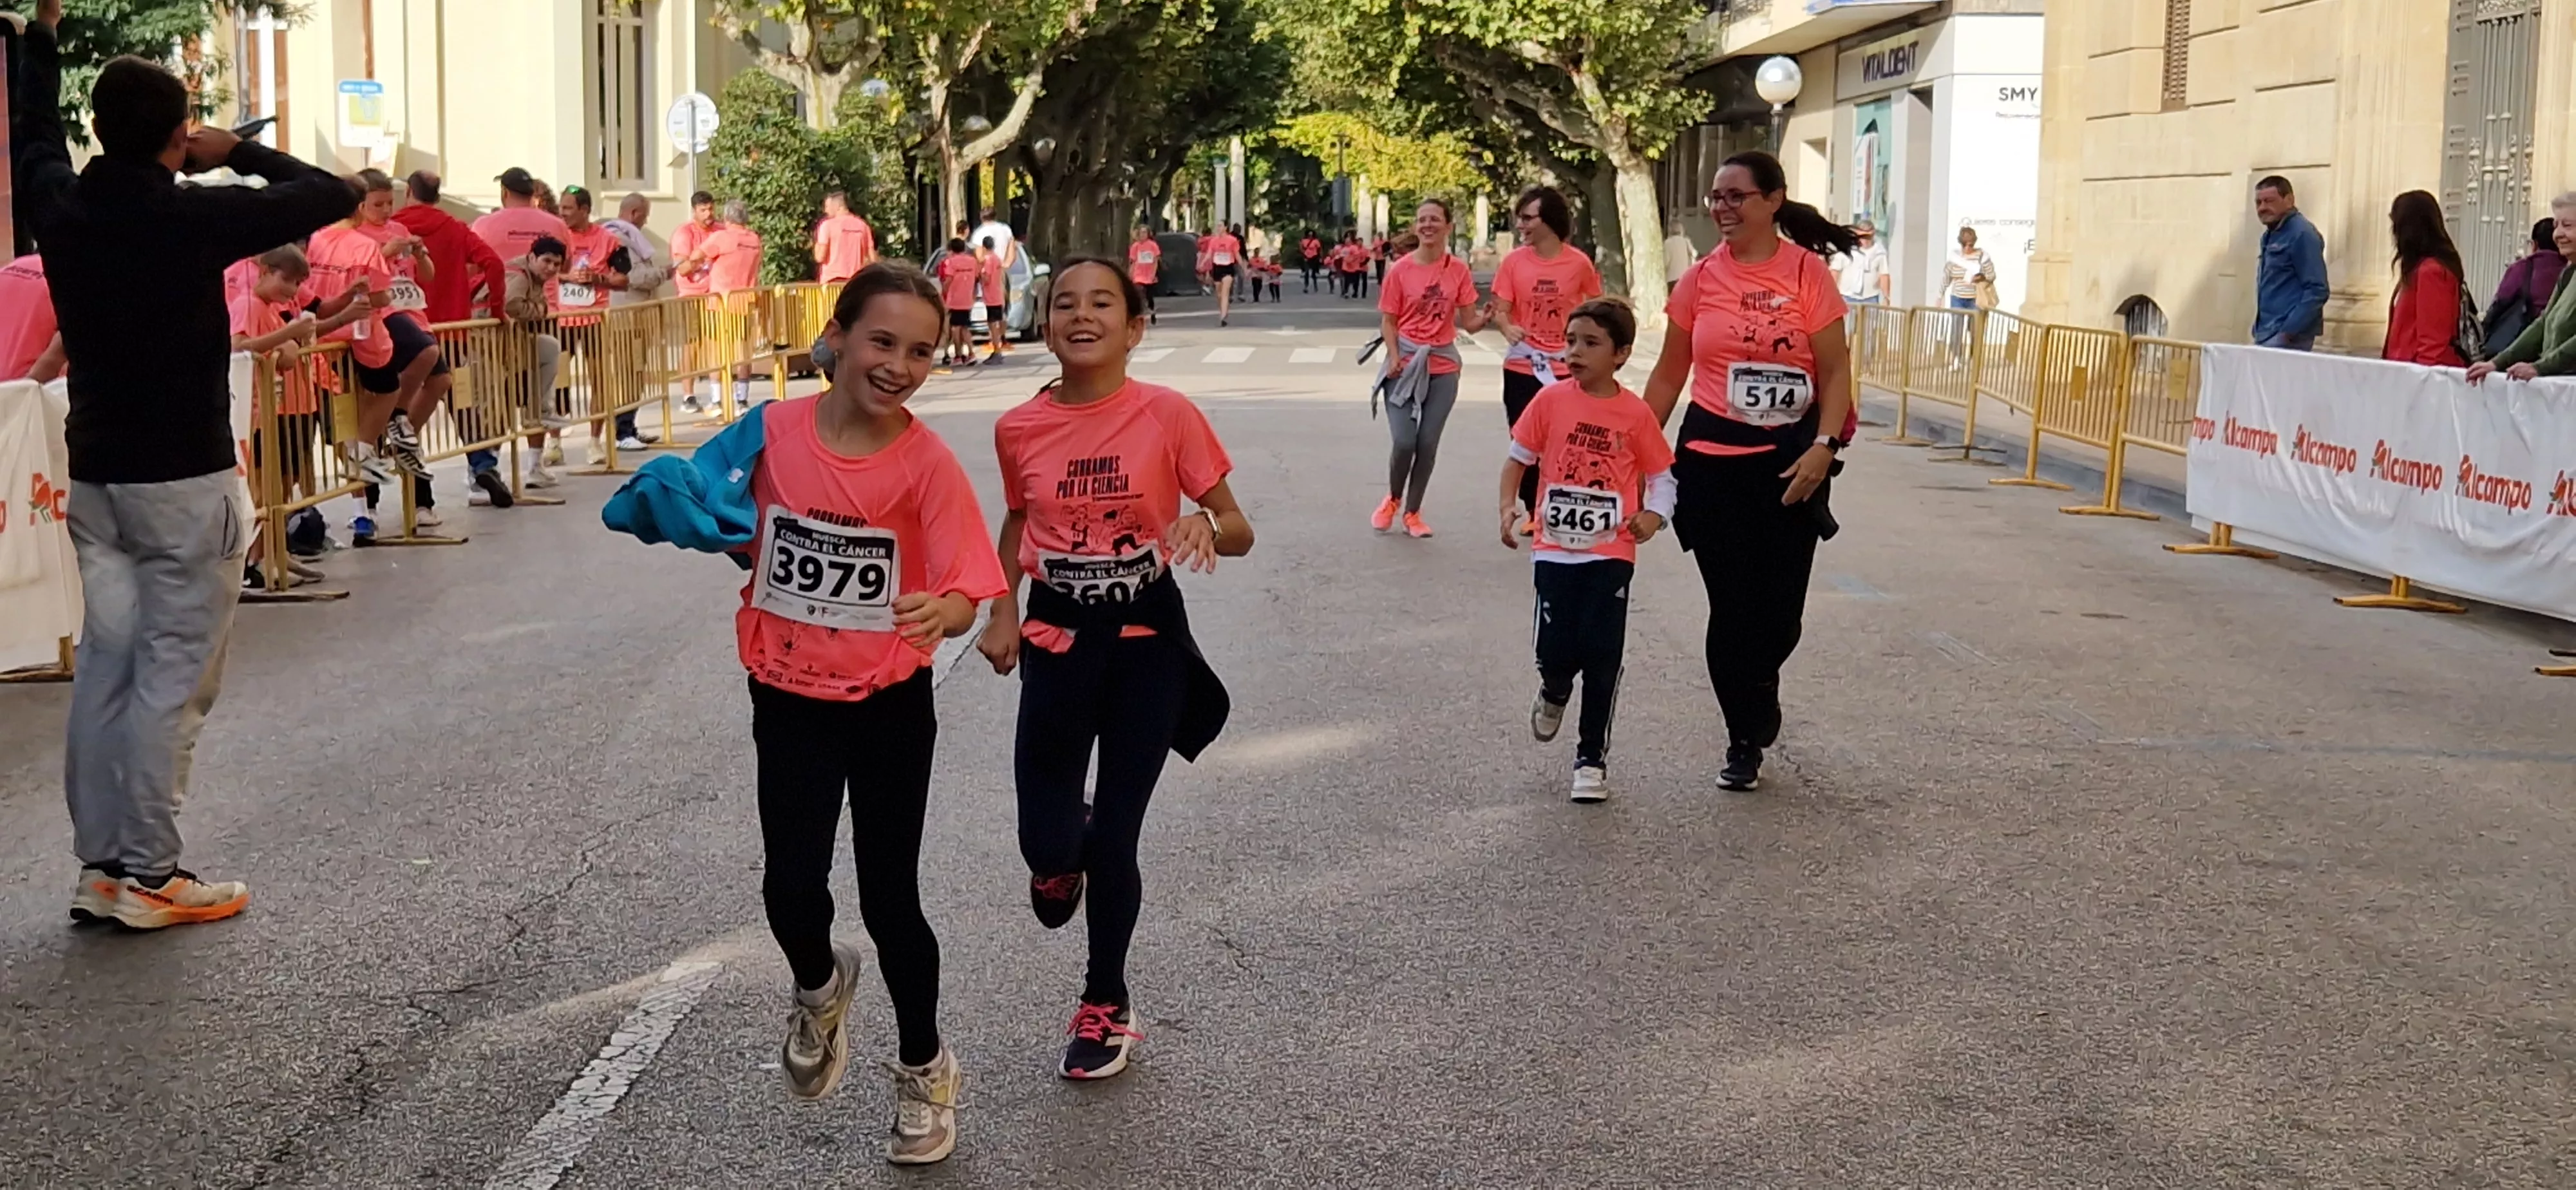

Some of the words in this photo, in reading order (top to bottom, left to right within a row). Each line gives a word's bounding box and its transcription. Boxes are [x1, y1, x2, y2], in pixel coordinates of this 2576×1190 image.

[1862, 41, 1919, 84] VITALDENT
[563, 287, 592, 299] 2407
[1745, 386, 1796, 408] 514
[2221, 410, 2278, 460] Alcampo
[2291, 423, 2357, 477] Alcampo
[1067, 455, 1121, 478] CORRAMOS
[2370, 439, 2443, 496] Alcampo
[1056, 479, 1075, 500] POR
[1077, 478, 1088, 497] LA
[1091, 473, 1130, 495] CIENCIA
[2455, 454, 2532, 516] Alcampo
[1548, 505, 1611, 532] 3461
[780, 529, 819, 551] CONTRA
[822, 543, 836, 554] EL
[838, 545, 887, 558] CÁNCER
[812, 531, 846, 545] HUESCA
[772, 546, 886, 601] 3979
[1052, 568, 1094, 579] CONTRA
